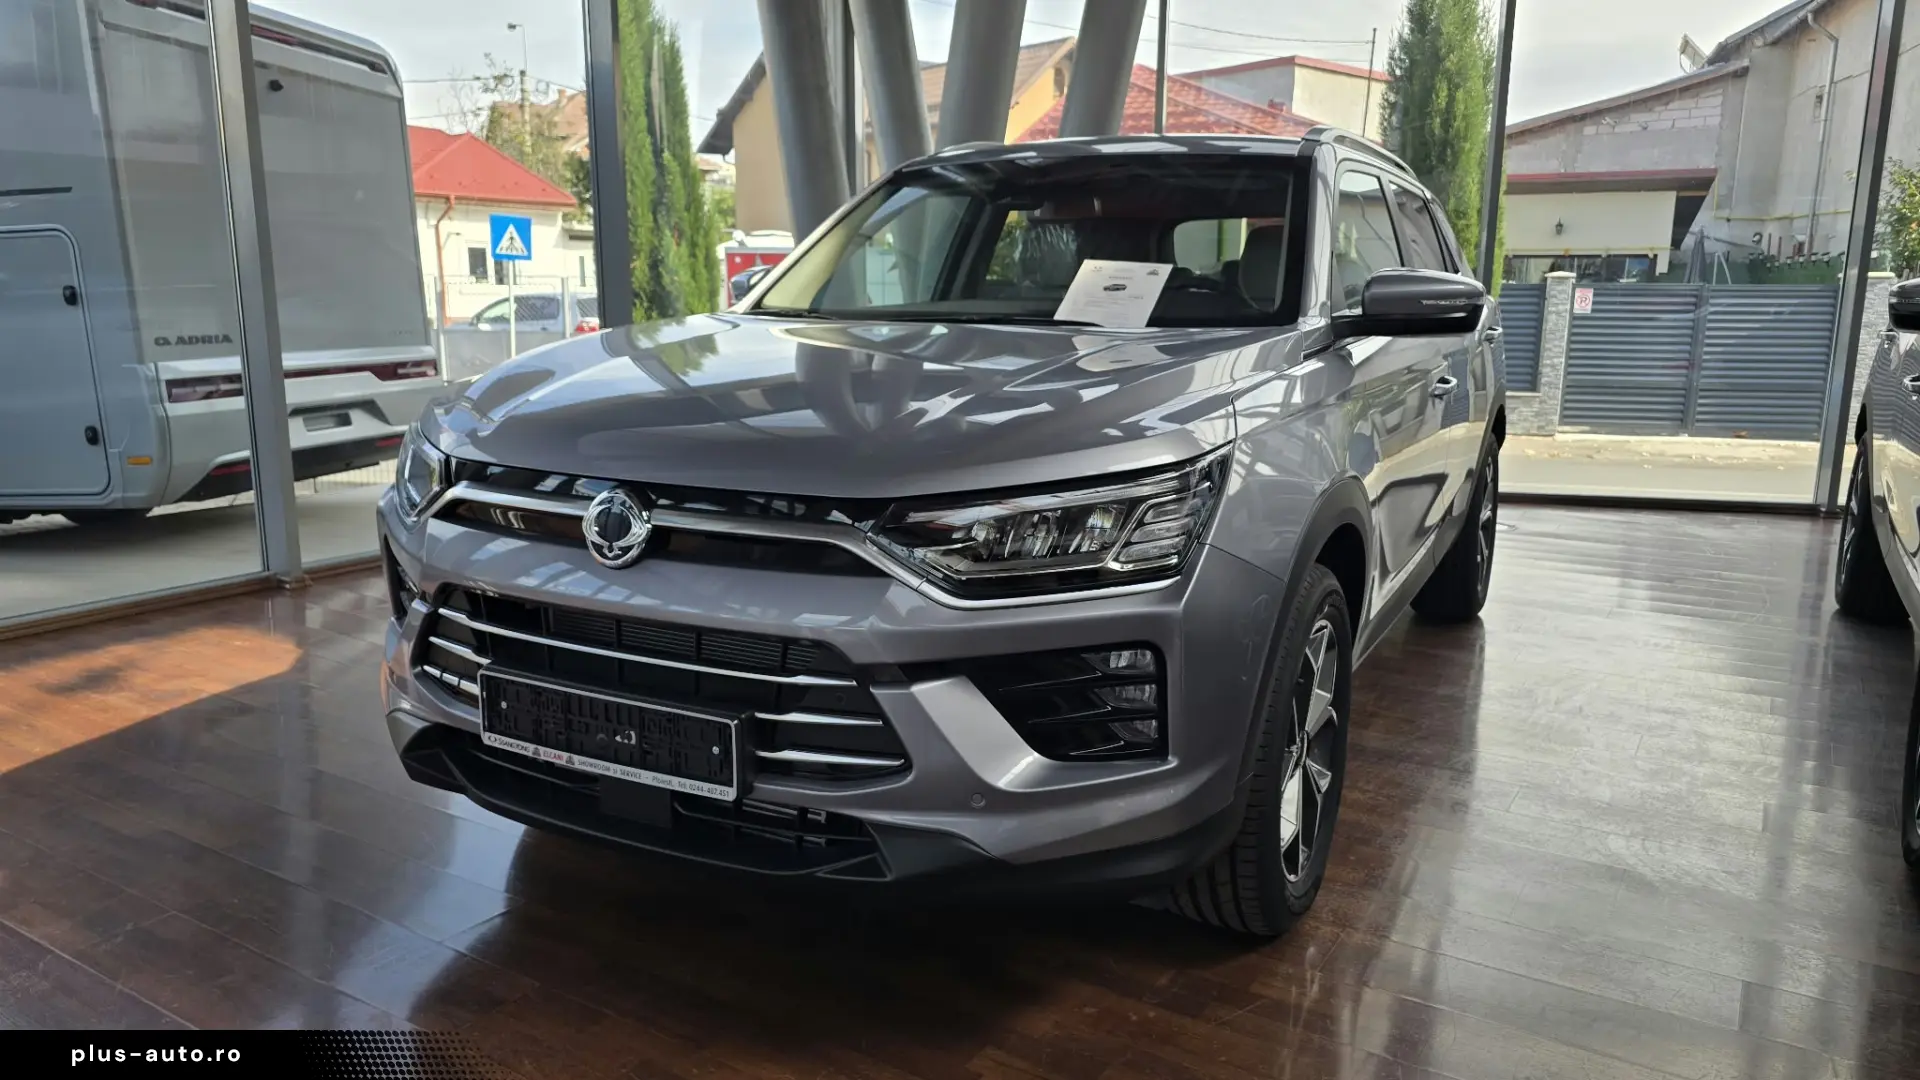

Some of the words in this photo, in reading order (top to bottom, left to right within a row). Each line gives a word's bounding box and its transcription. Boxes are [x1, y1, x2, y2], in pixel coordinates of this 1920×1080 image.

[174, 333, 233, 346] ADRIA
[499, 738, 531, 754] SSANGYONG
[577, 758, 611, 773] SHOWROOM
[619, 769, 643, 780] SERVICE
